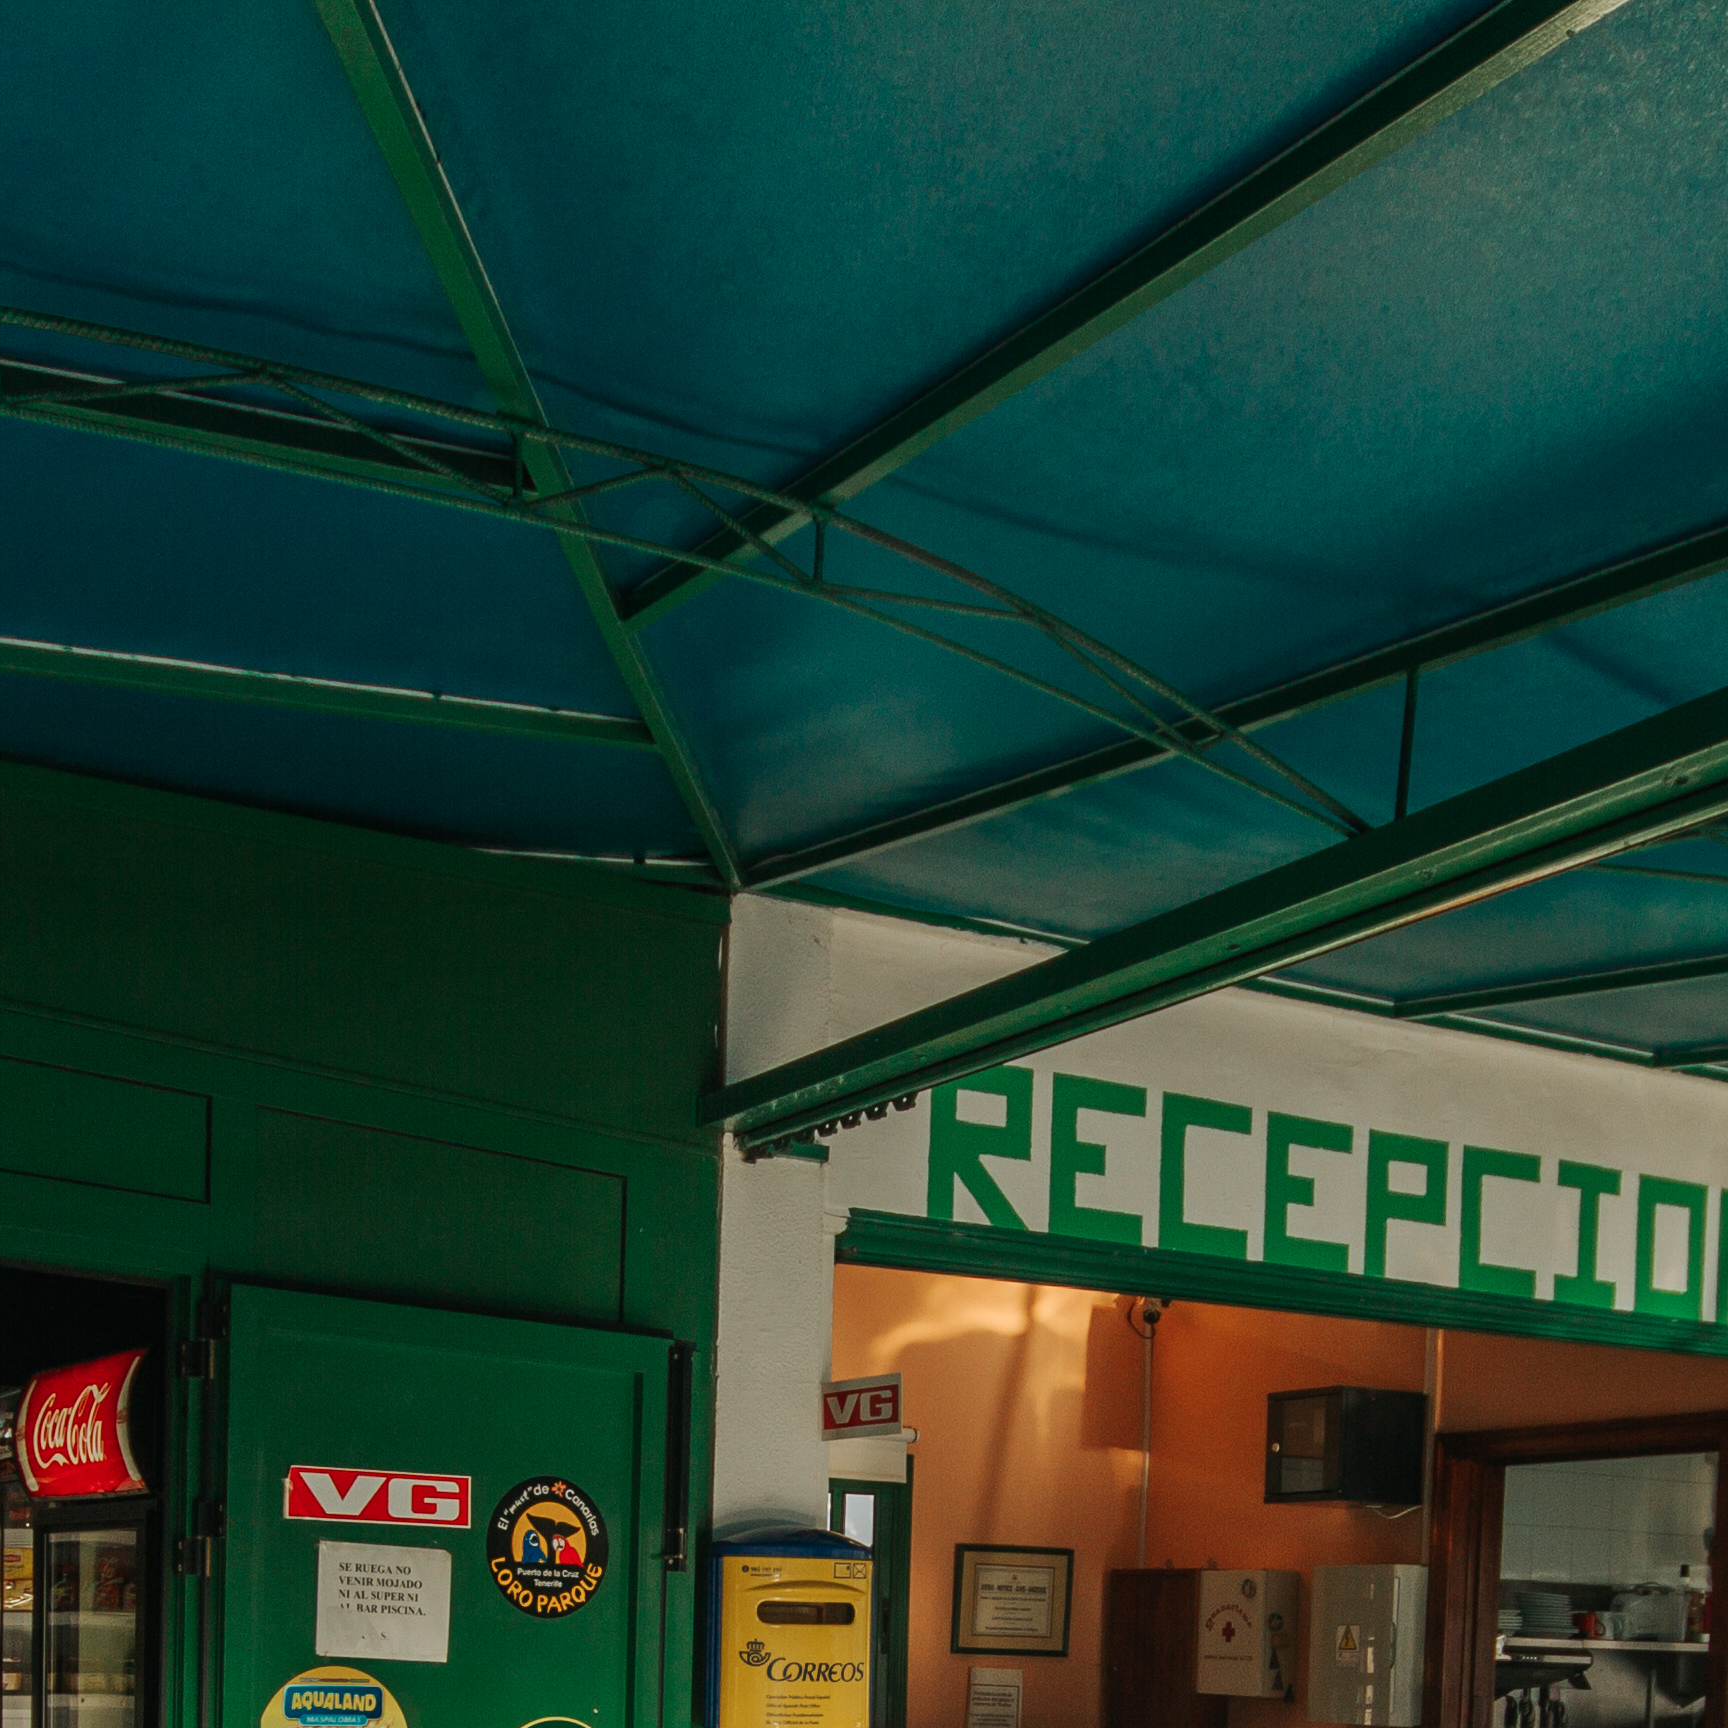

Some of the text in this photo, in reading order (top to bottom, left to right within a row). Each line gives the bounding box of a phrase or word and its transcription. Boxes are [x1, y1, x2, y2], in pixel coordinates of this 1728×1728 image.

[826, 1390, 892, 1425] VG
[299, 1472, 460, 1521] VG
[533, 1484, 550, 1496] de
[565, 1488, 600, 1537] Canarias
[338, 1562, 411, 1576] SE RUEGA NO
[338, 1575, 423, 1590] VENIR MOJADO
[491, 1556, 603, 1614] LORO PARQUE
[338, 1589, 419, 1603] NI AL SUPER NI
[357, 1603, 378, 1614] BAR
[381, 1605, 427, 1616] PISCINA.
[766, 1657, 865, 1683] CORREOS
[291, 1690, 377, 1712] AQUALAND
